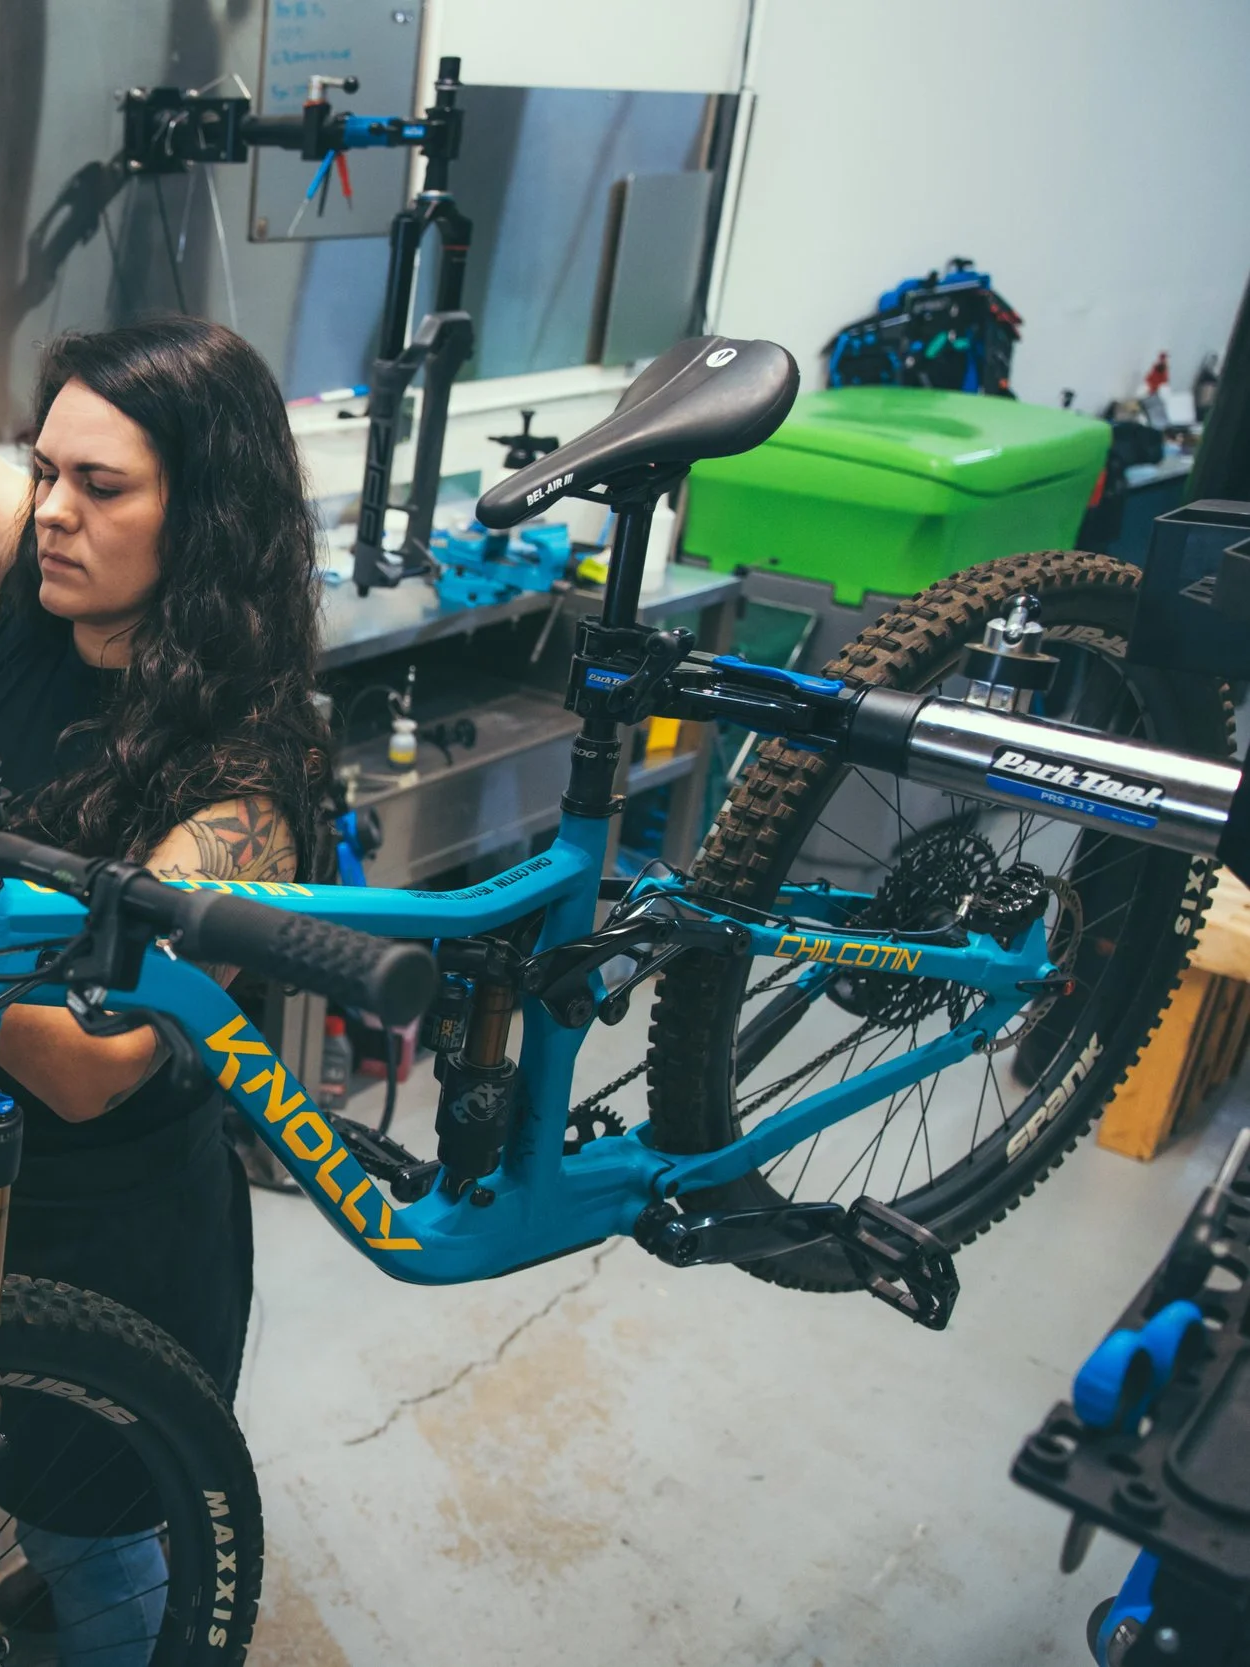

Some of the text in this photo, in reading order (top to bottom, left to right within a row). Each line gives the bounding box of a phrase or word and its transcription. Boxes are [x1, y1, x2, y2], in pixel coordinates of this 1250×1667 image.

[493, 857, 553, 889] CHILCOTIN
[1174, 855, 1209, 936] XIS
[774, 934, 922, 972] CHILCOTIN
[205, 1014, 424, 1250] KNOLLY
[202, 1489, 237, 1649] MAXXIS
